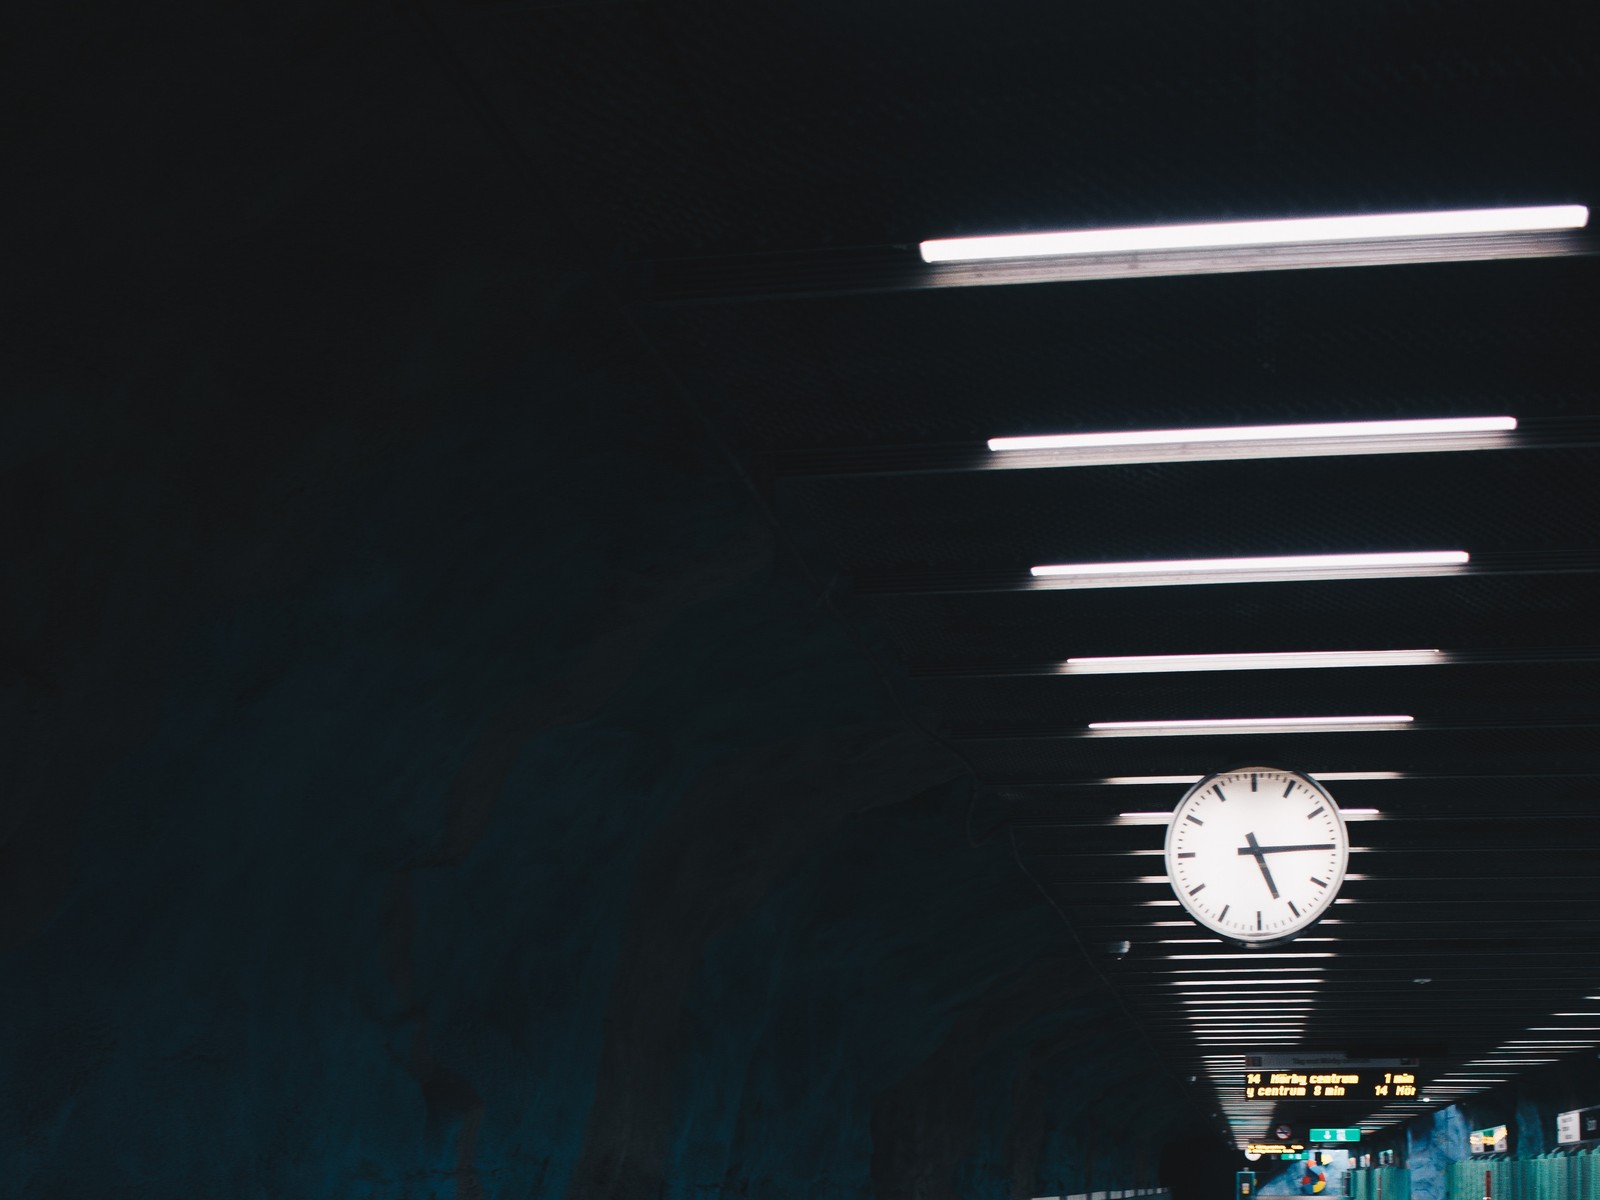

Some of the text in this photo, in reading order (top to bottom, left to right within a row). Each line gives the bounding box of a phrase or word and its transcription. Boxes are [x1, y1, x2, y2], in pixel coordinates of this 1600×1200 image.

[1247, 1074, 1261, 1084] 14
[1309, 1074, 1359, 1084] centrum
[1384, 1074, 1391, 1084] 1
[1393, 1074, 1414, 1084] min
[1257, 1086, 1306, 1096] centrum
[1313, 1086, 1322, 1096] 8
[1324, 1086, 1345, 1096] min
[1375, 1086, 1388, 1096] 14
